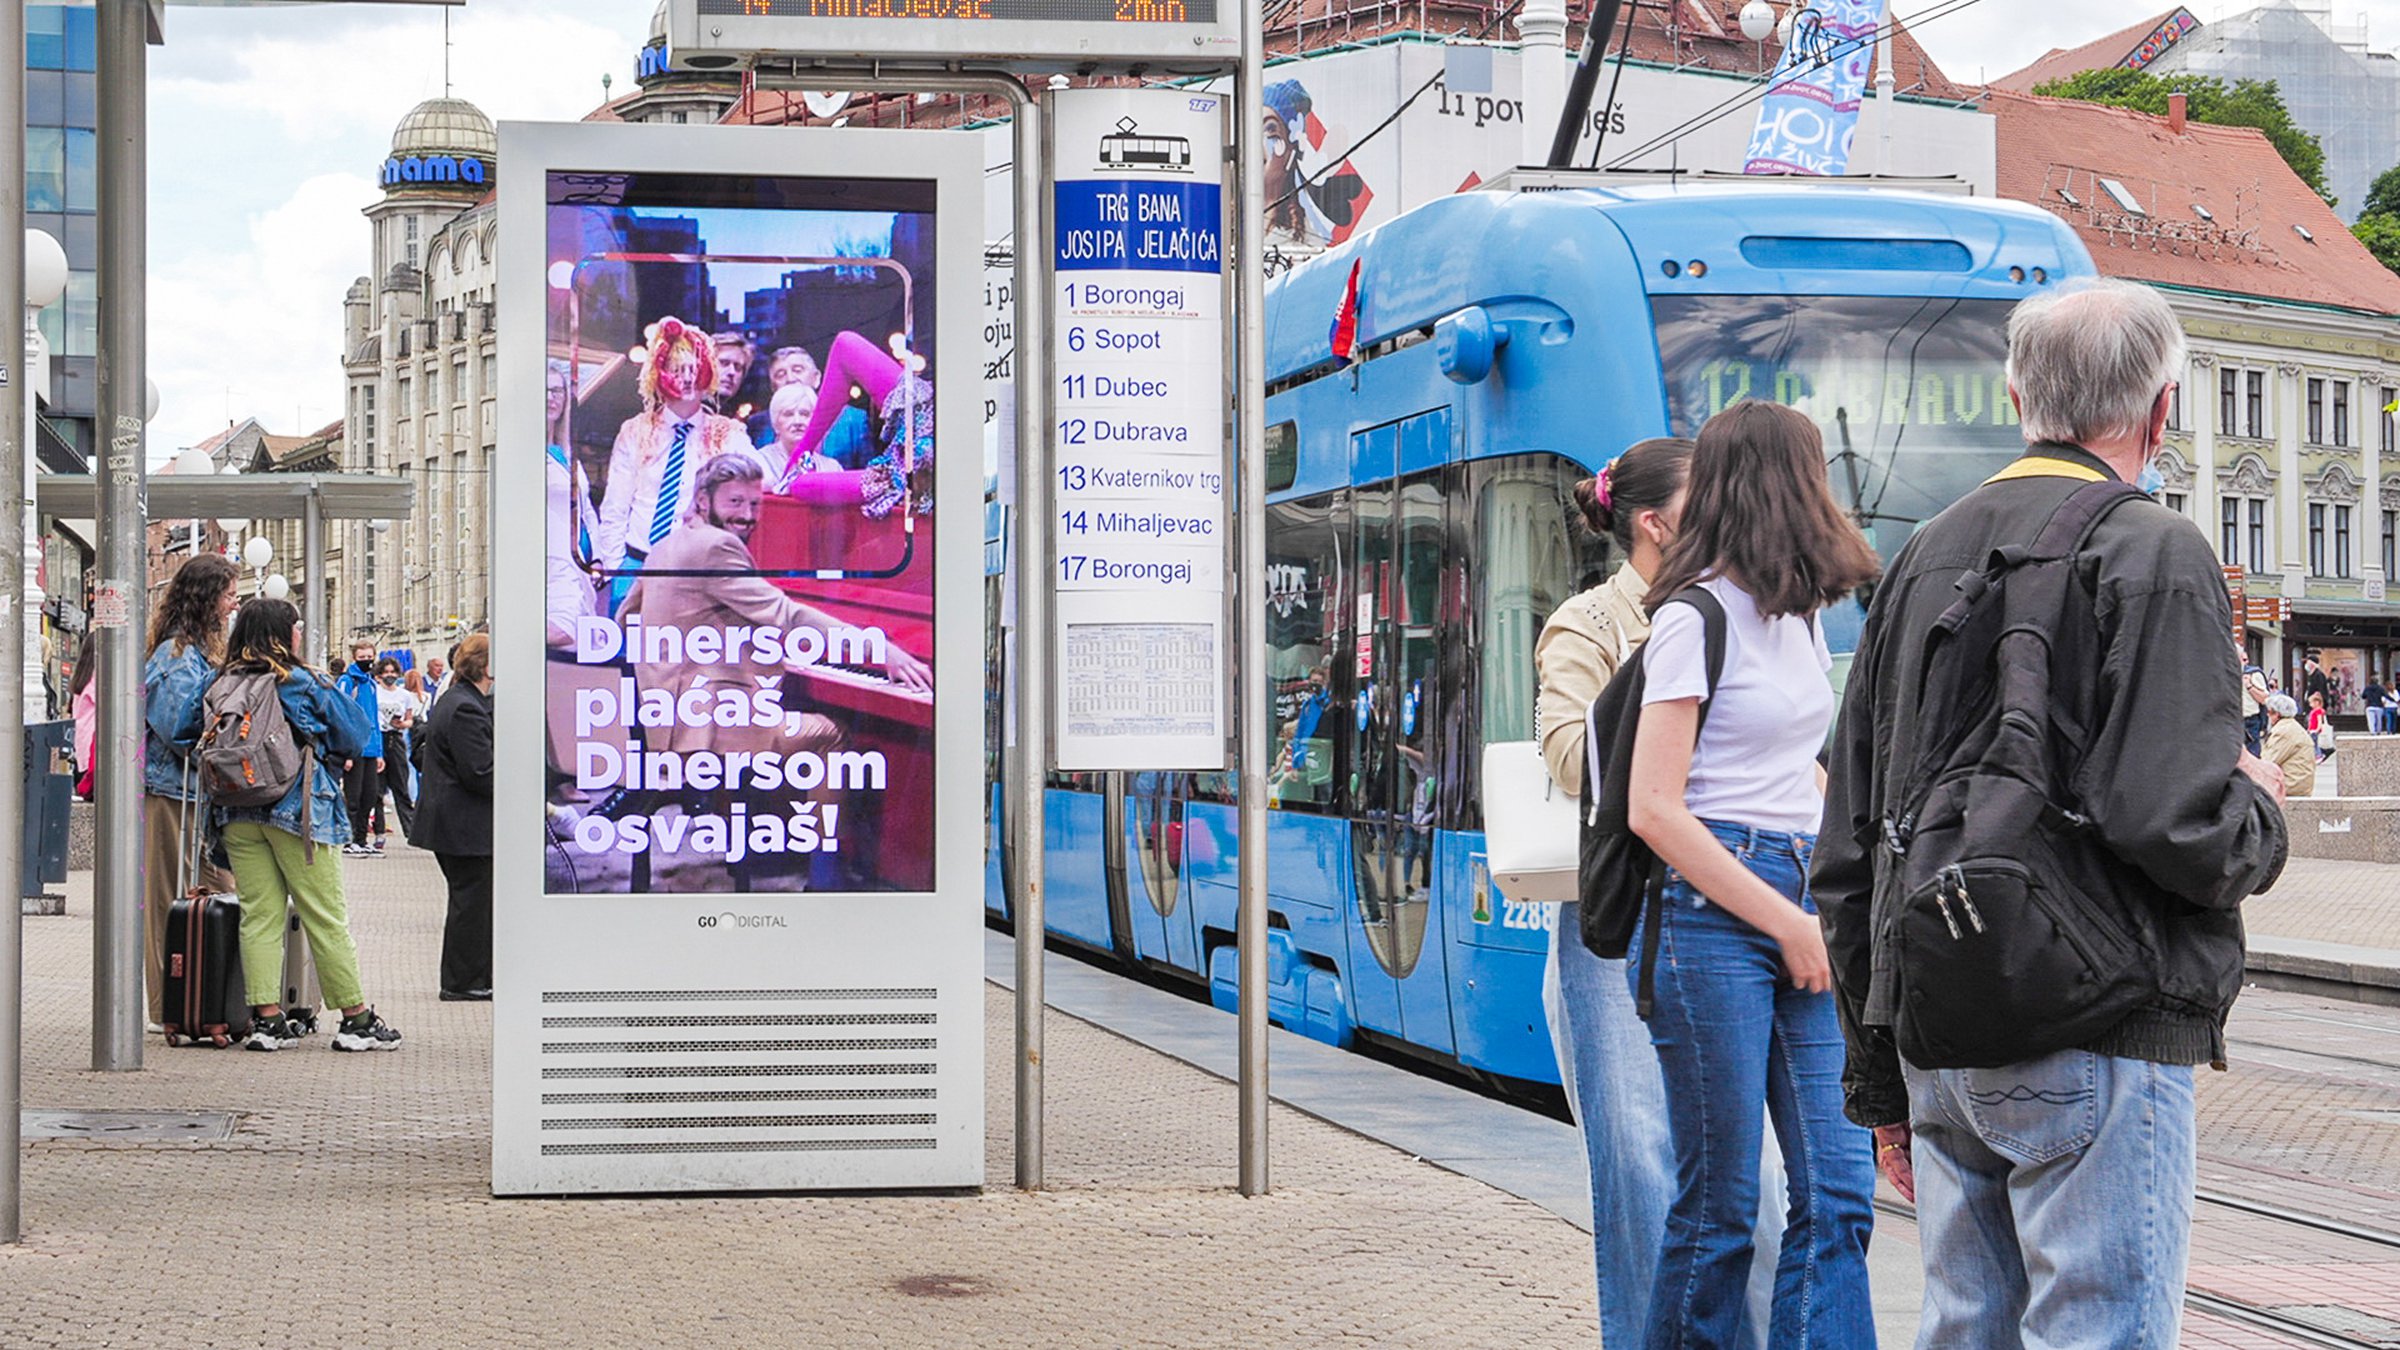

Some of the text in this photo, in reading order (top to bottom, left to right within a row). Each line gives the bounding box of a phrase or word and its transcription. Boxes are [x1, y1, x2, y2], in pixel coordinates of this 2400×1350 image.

[384, 154, 485, 185] nama
[1096, 193, 1181, 222] TRG BANA
[1061, 226, 1218, 262] JOSIPA JELAČIĆA
[1065, 282, 1184, 310] 1 Borongaj
[1068, 326, 1161, 353] 6 Sopot
[1062, 374, 1168, 400] 11 Dubec
[1058, 418, 1188, 445] 12 Dubrava
[1058, 465, 1220, 495] 13 Kvaternikov trg
[1061, 510, 1212, 538] 14 Mihaljevac
[1059, 555, 1191, 584] 17 Borongaj
[576, 614, 887, 664] Dinersom
[576, 675, 801, 737] plaćaš,
[576, 741, 887, 791] Dinersom
[575, 801, 839, 863] osvajaš!
[698, 915, 788, 928] GO DIGITAL
[1503, 898, 1551, 932] 2288
